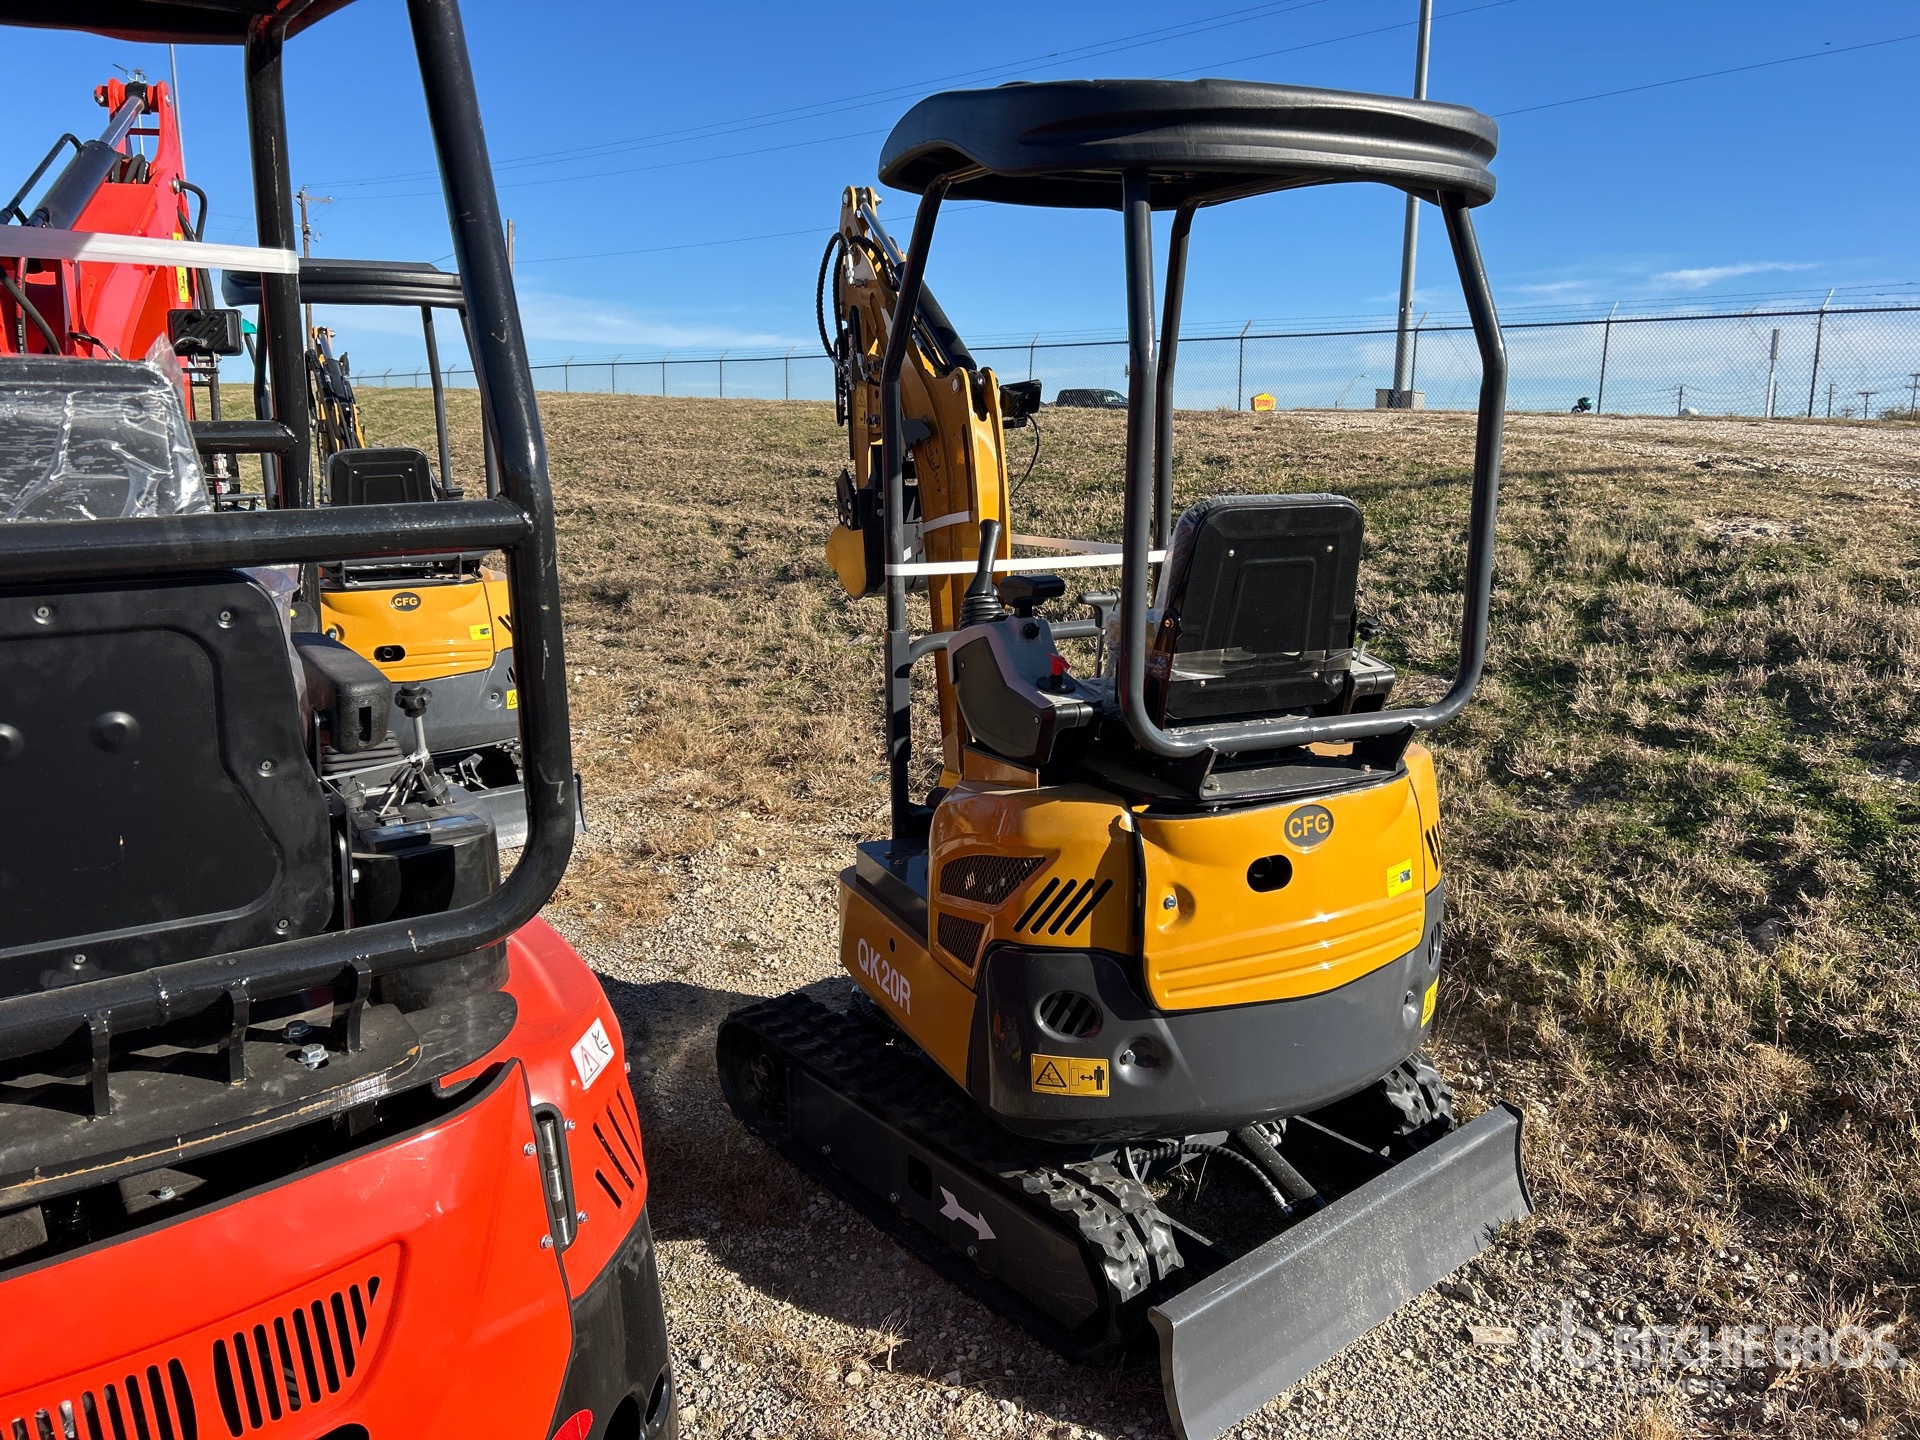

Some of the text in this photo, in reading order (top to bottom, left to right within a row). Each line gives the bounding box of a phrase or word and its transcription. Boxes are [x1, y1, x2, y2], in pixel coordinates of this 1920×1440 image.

[394, 597, 418, 607] CFG
[1288, 813, 1330, 839] CFG
[857, 937, 912, 1016] QK20R
